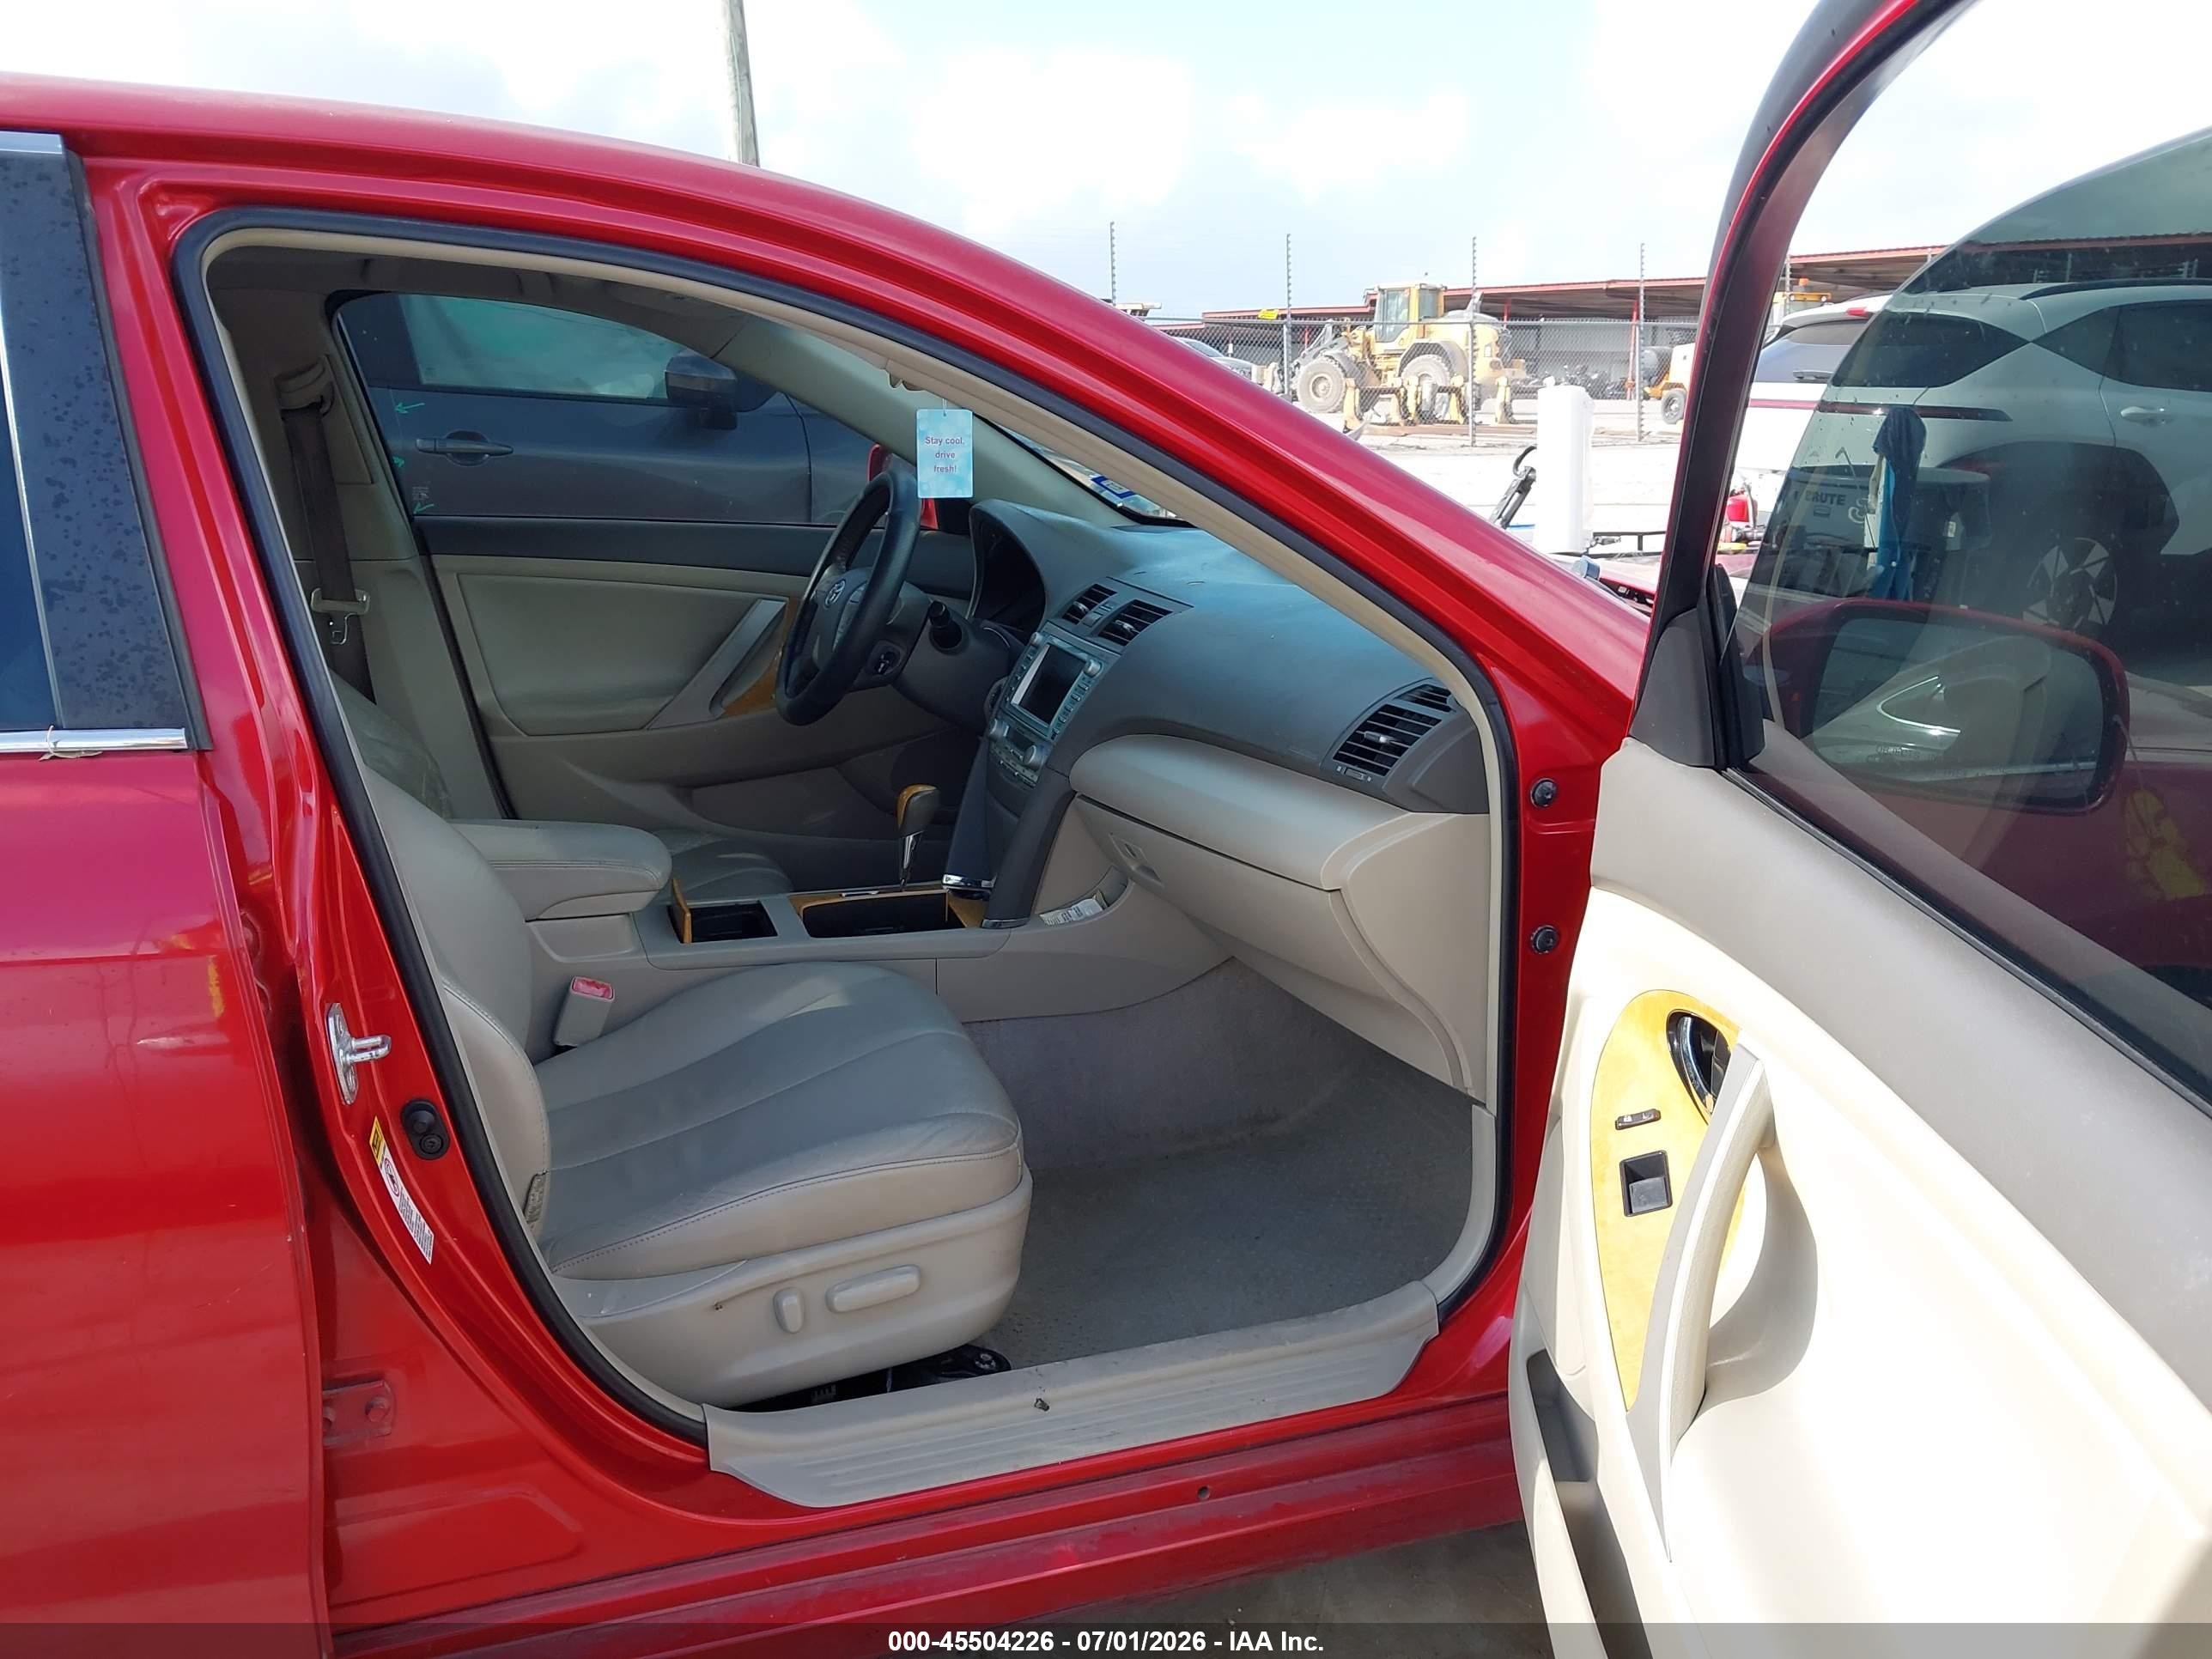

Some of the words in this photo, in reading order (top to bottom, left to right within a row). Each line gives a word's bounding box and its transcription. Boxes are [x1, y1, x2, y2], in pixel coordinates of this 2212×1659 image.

[925, 436, 943, 447] Stay
[935, 450, 956, 459] drive
[933, 465, 957, 473] fresh!
